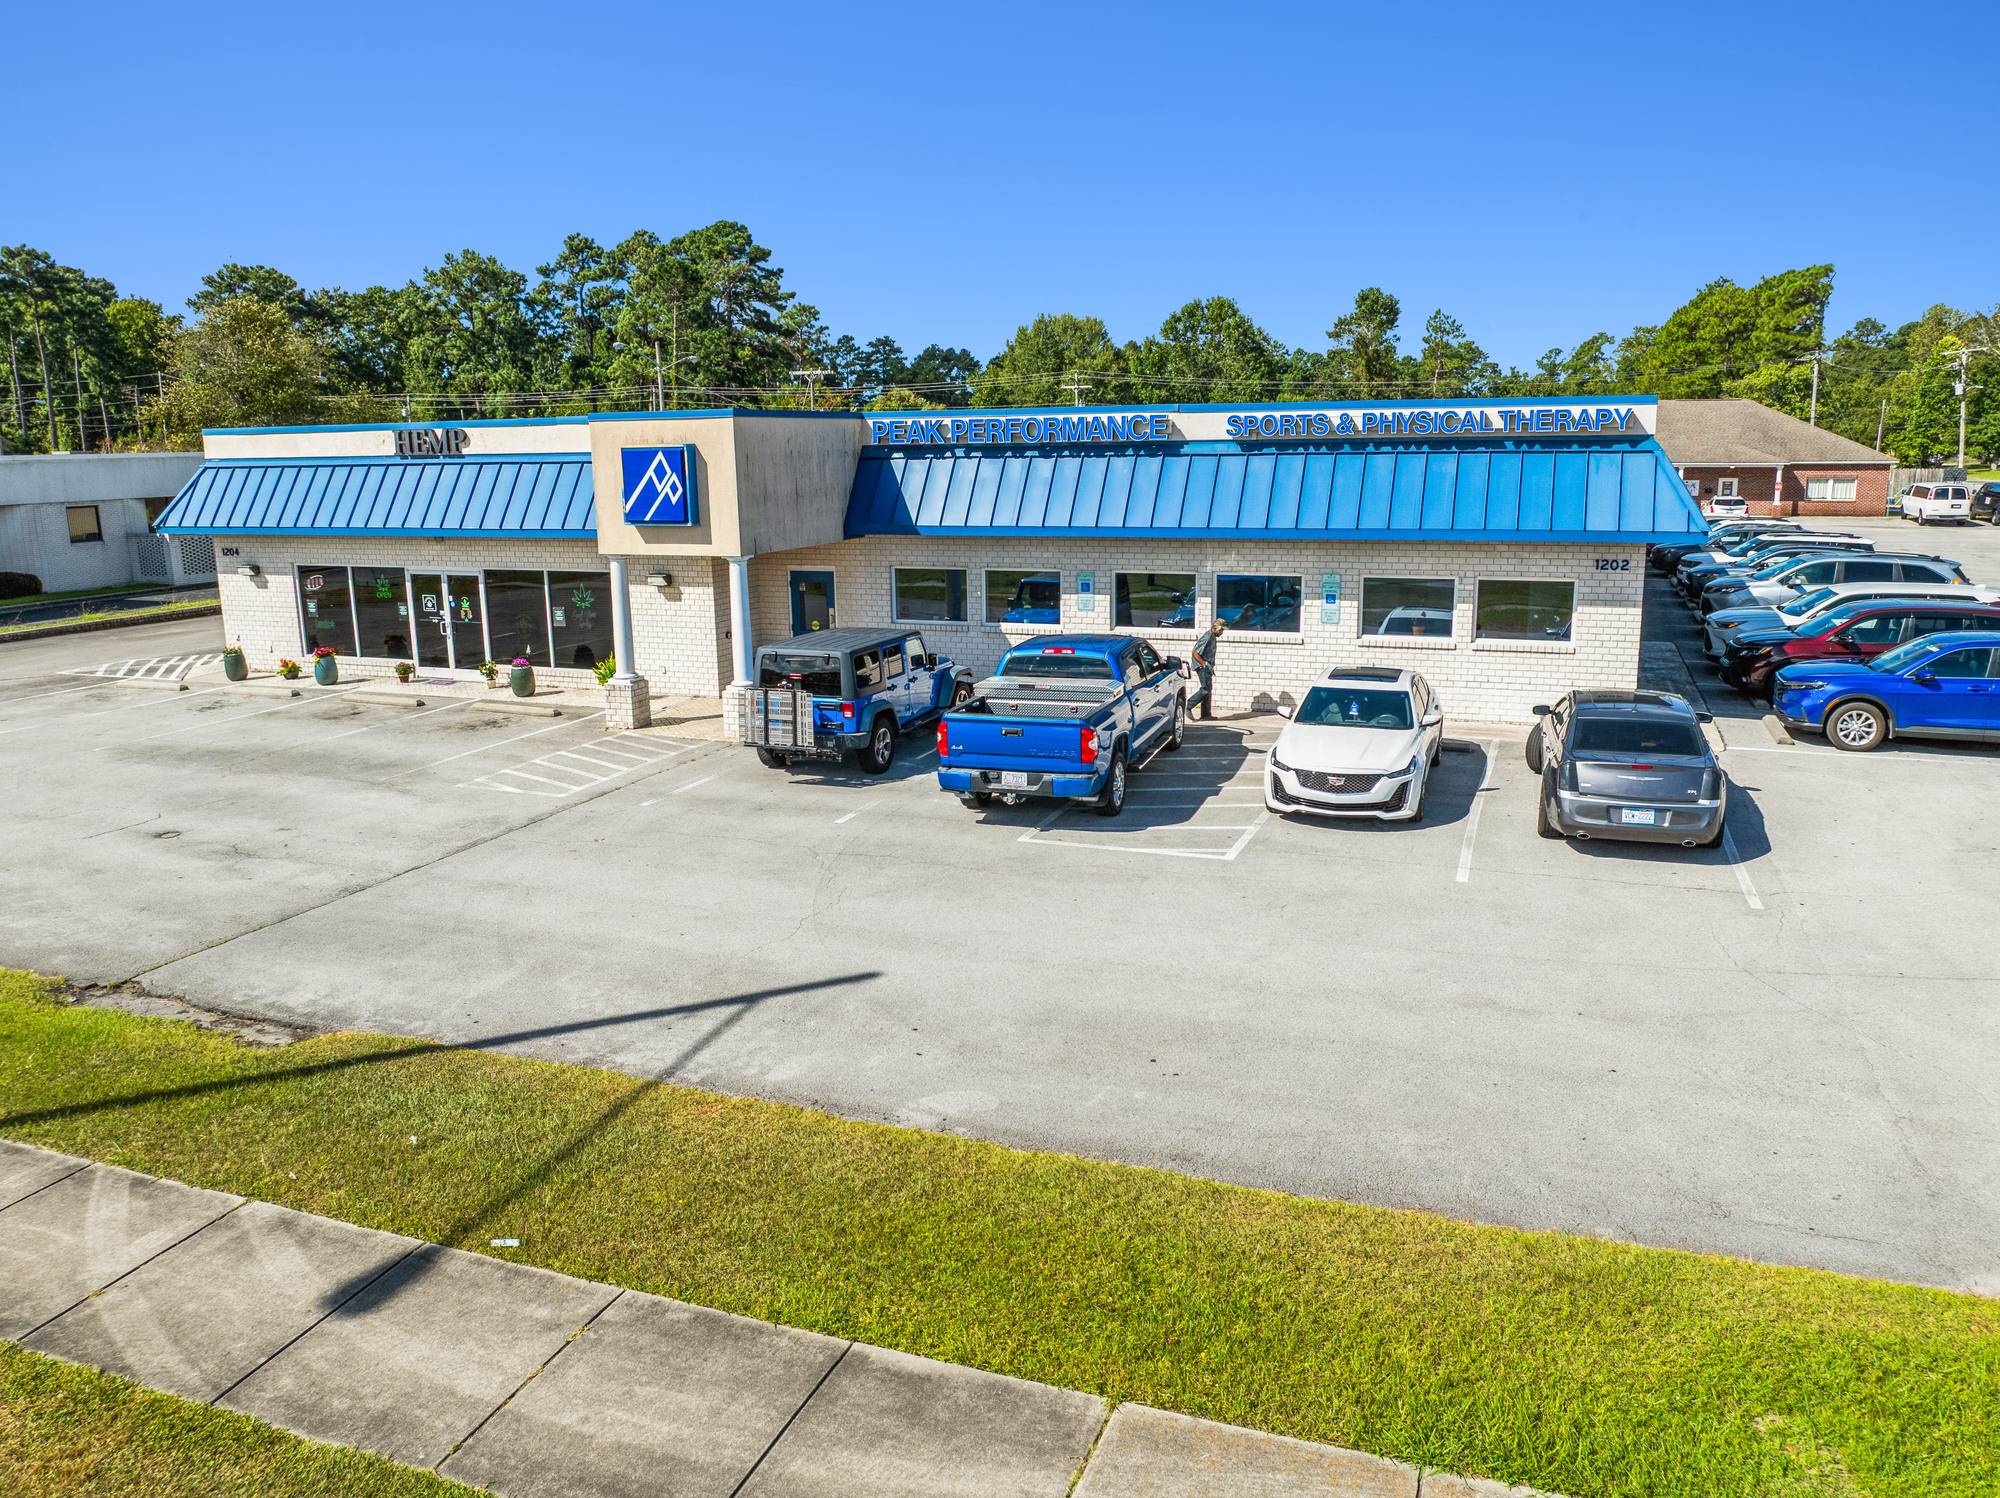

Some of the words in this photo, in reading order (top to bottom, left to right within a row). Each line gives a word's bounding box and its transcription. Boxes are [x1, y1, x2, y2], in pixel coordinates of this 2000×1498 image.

[872, 419, 945, 444] PEAK
[950, 414, 1168, 444] PERFORMANCE
[1226, 412, 1329, 437] SPORTS
[1335, 412, 1354, 435] &
[1361, 410, 1495, 434] PHYSICAL
[1497, 407, 1633, 432] THERAPY
[392, 428, 467, 455] HEMP
[221, 547, 240, 556] 1204
[1595, 559, 1630, 571] 1202
